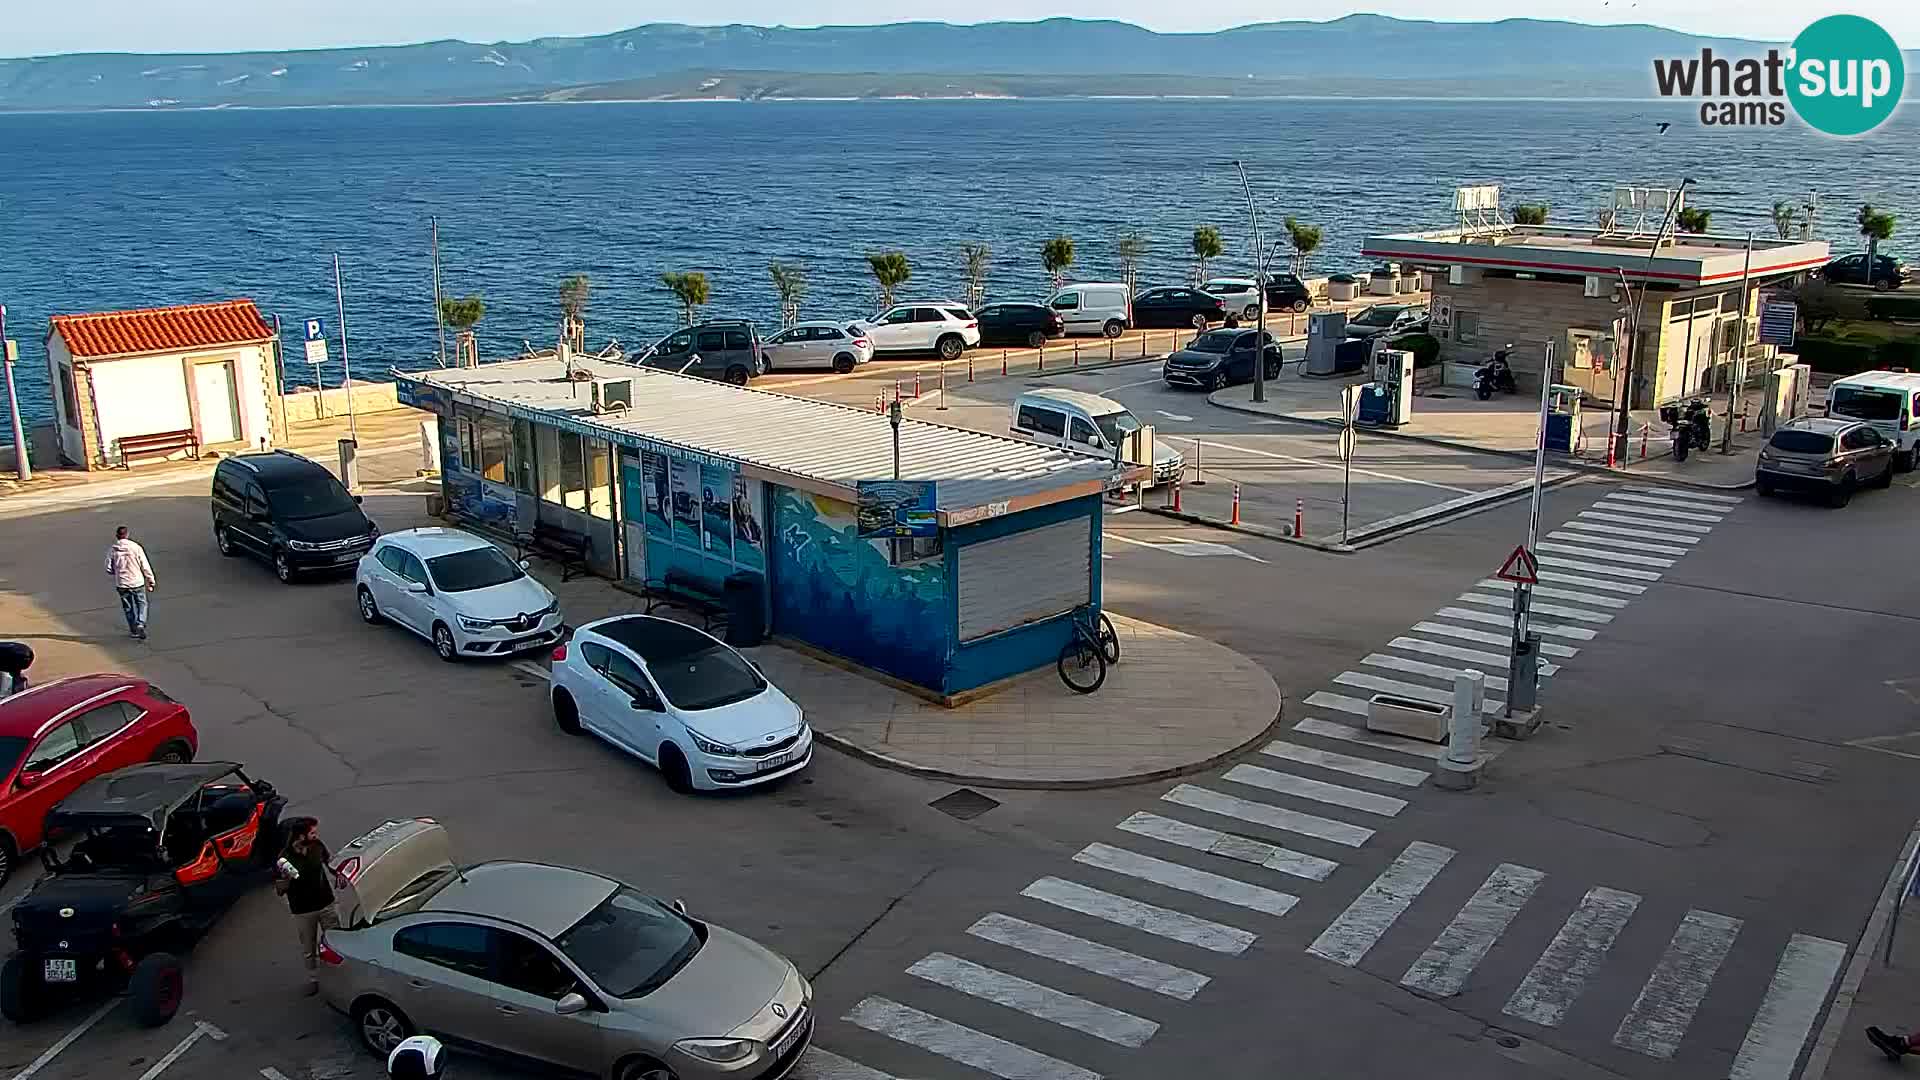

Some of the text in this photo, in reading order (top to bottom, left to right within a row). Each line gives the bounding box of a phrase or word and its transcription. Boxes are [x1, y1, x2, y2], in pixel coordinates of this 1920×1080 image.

[307, 320, 320, 338] P
[636, 438, 650, 450] BUS
[650, 441, 682, 458] STATION
[683, 450, 709, 465] TICKET
[710, 457, 737, 472] OFFICE
